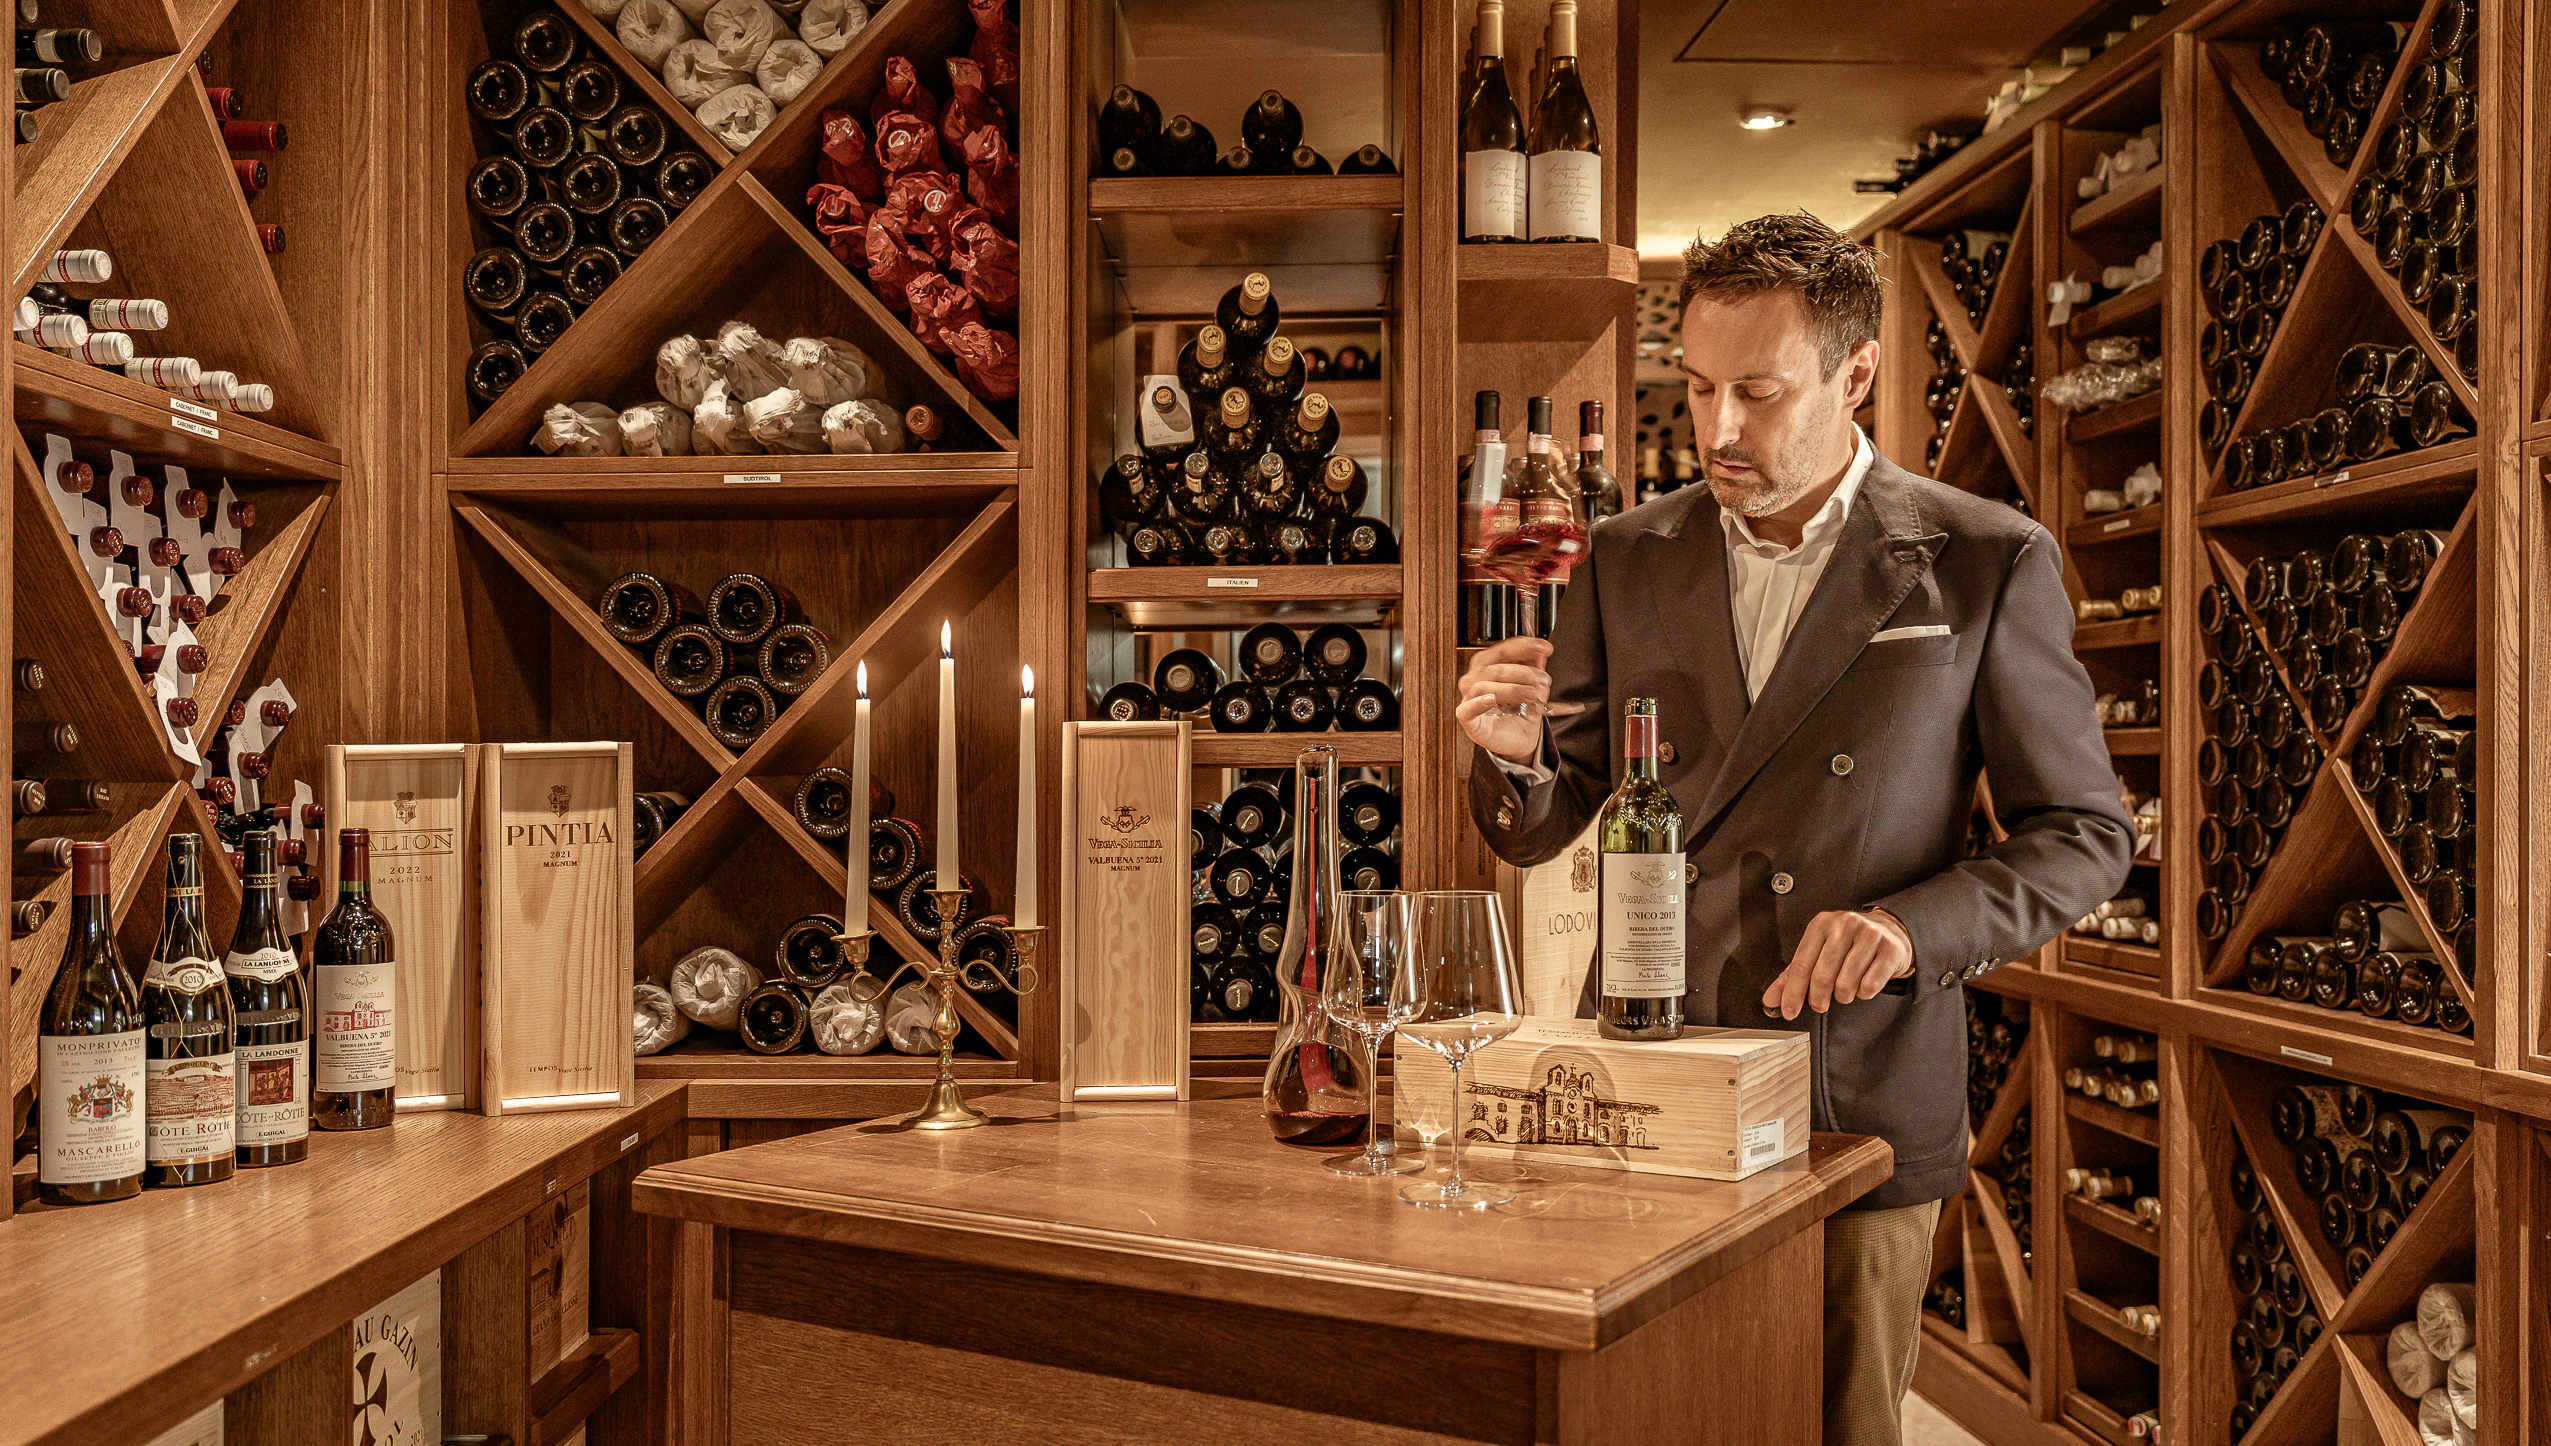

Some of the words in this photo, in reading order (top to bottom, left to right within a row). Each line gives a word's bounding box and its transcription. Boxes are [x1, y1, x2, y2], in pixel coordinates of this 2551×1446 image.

[506, 821, 615, 847] PINTIA
[1088, 838, 1163, 849] VEGA-SICILIA
[550, 850, 571, 859] 2021
[543, 860, 578, 868] MAGNUM
[1088, 856, 1134, 864] VALBUENA
[1145, 855, 1163, 864] 2021
[389, 866, 421, 875] 2022
[377, 875, 433, 885] MAGNUM
[1627, 911, 1658, 920] UNICO
[1659, 911, 1676, 920] 2013
[260, 952, 277, 960] 2010
[184, 975, 202, 984] 2010
[325, 1033, 369, 1041] VALBUENA
[57, 1037, 140, 1052] MONPRIVATO
[255, 1047, 299, 1058] LANDONNE
[94, 1057, 114, 1066] 2013
[529, 1065, 558, 1073] TEMPOS
[88, 1124, 117, 1133] BAROLO
[149, 1124, 191, 1137] CÔTE
[57, 1140, 141, 1157] MASCARELLO
[381, 1314, 420, 1374] GAZIN
